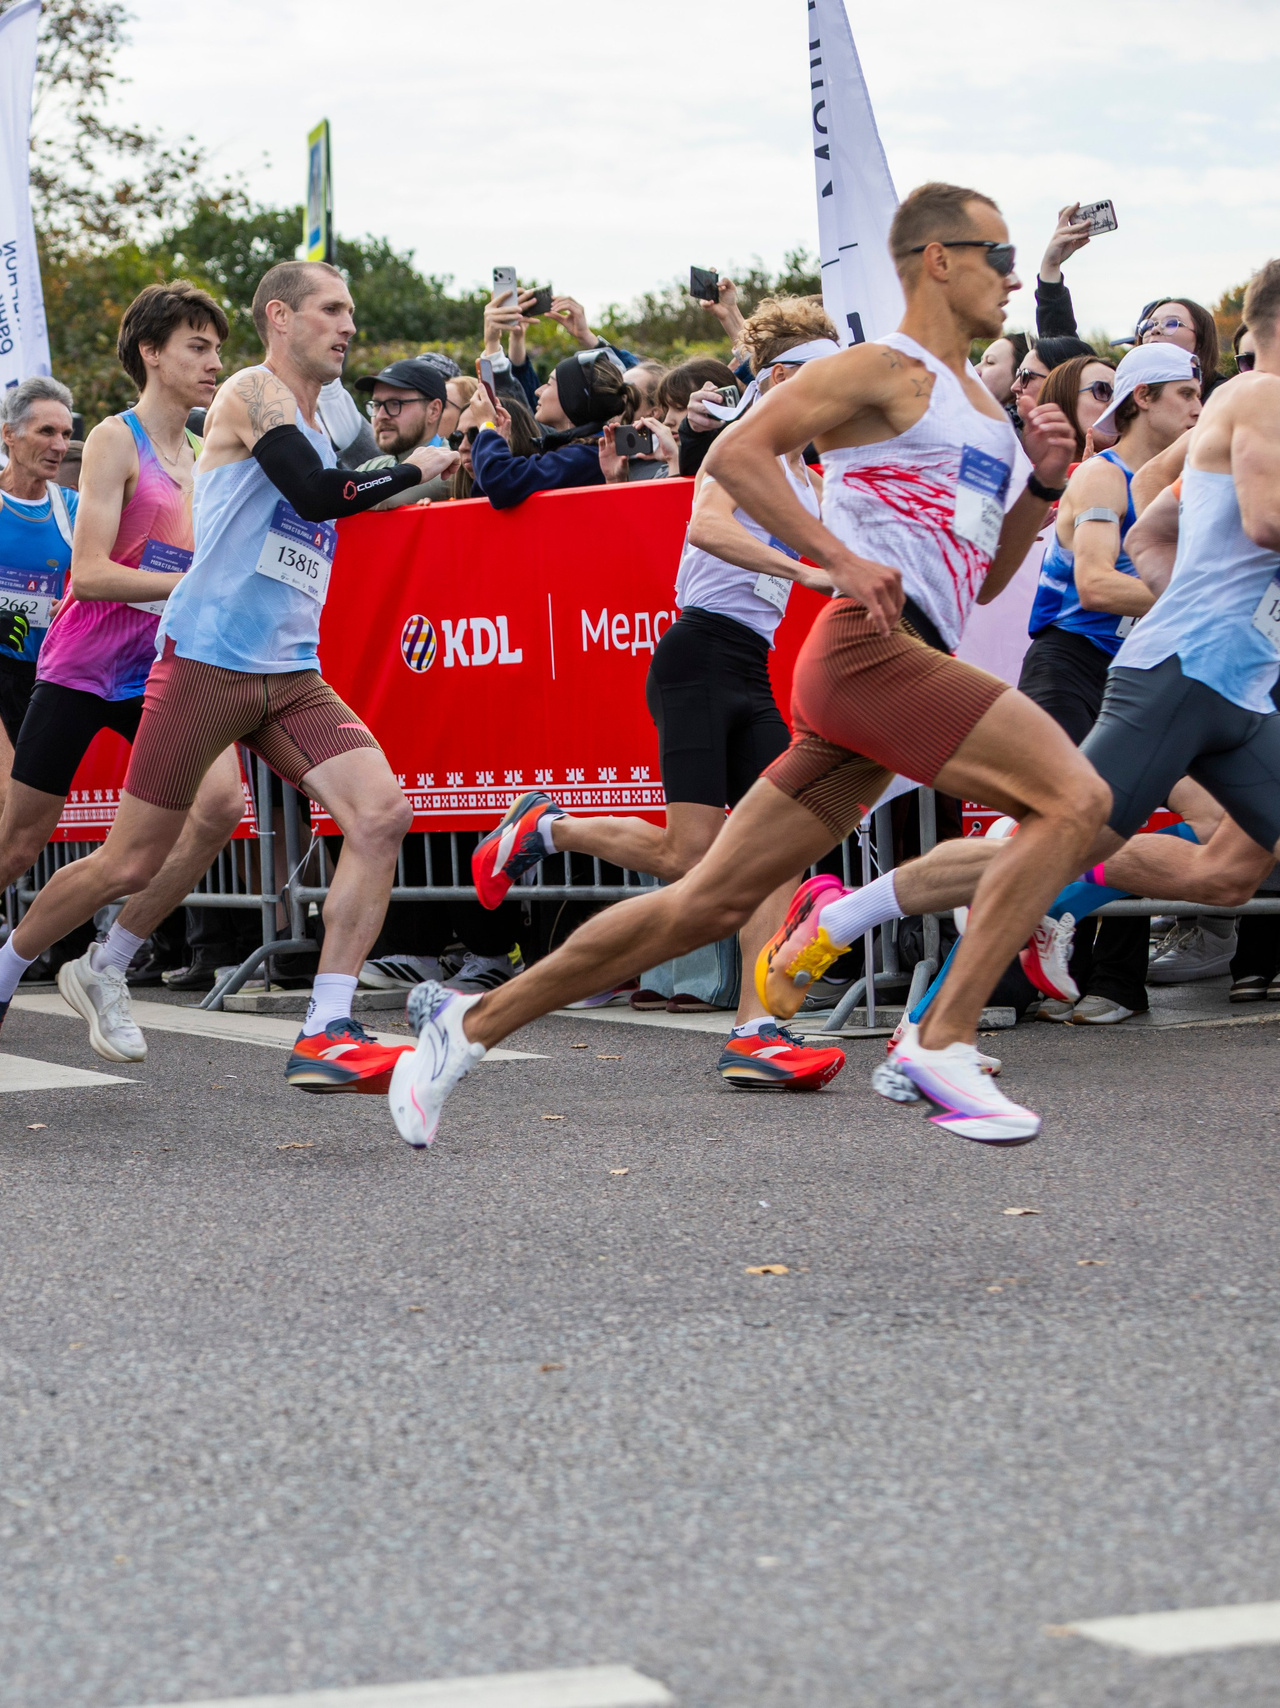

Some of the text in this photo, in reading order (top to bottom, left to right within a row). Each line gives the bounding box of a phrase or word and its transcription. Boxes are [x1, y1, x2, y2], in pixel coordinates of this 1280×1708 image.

[357, 475, 393, 492] COROS
[278, 546, 320, 580] 13815
[441, 615, 523, 668] KDL
[581, 608, 677, 657] Медс
